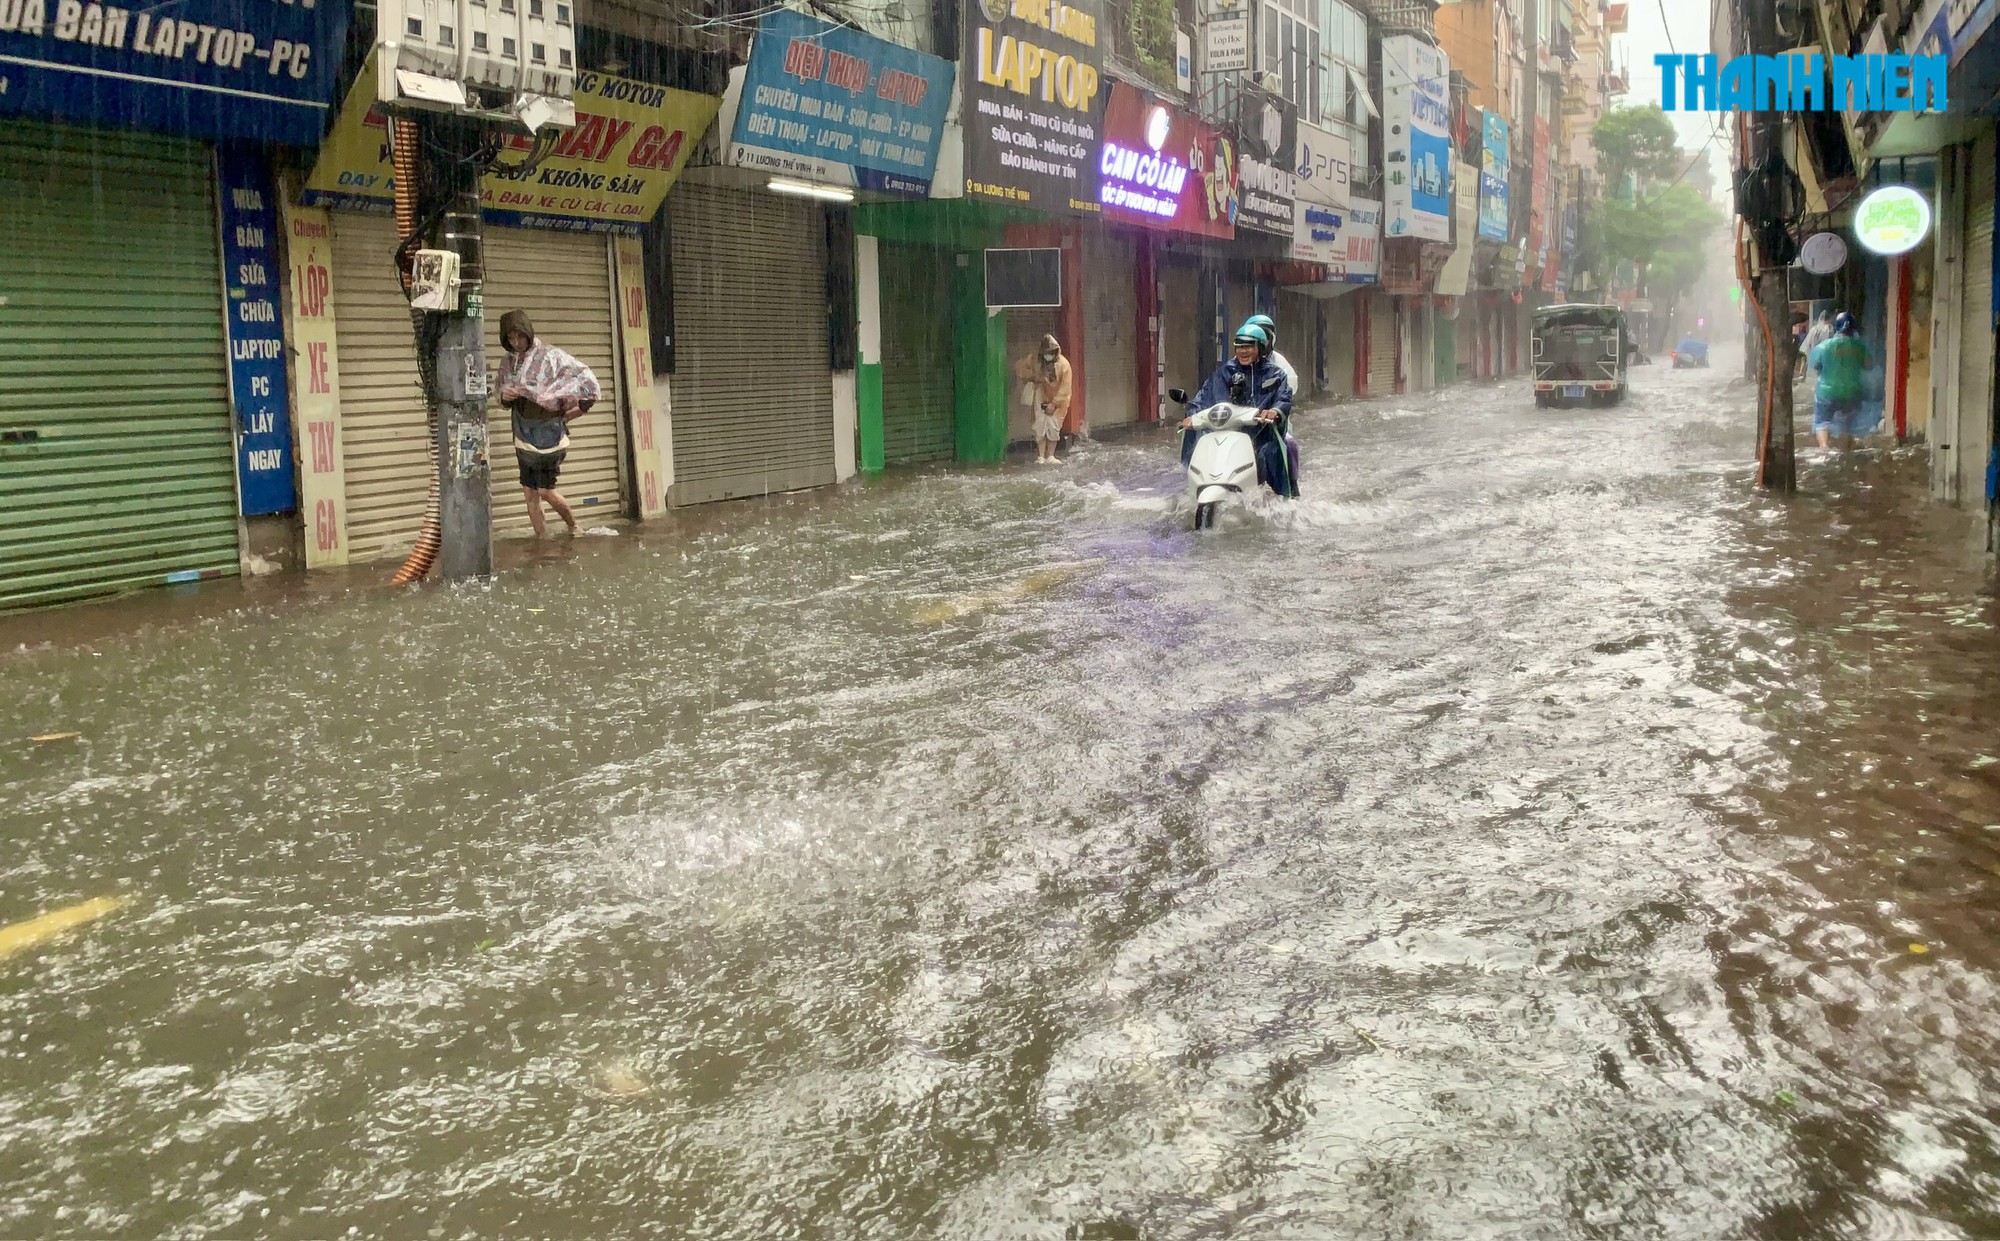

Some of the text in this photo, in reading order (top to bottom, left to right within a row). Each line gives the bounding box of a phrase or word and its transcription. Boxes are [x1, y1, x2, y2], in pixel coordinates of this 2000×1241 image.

[0, 0, 45, 38] UA
[133, 12, 310, 79] LAPTOP-PC
[1231, 48, 1245, 56] PIANO
[783, 38, 826, 85] ĐIỆN
[825, 49, 870, 98] THOẠI
[877, 66, 928, 108] LAPTOP
[978, 27, 1098, 112] LAPTOP
[575, 71, 666, 108] NG MOTOR
[755, 84, 799, 112] CHUYÊN
[800, 96, 821, 117] MUA
[823, 100, 845, 123] BÁN
[748, 112, 777, 138] ĐIỆN
[778, 119, 809, 145] THOẠI
[816, 128, 854, 151] LAPTOP
[978, 99, 1001, 117] MUA
[1003, 104, 1023, 121] BÁN
[1029, 112, 1047, 128] THU
[1048, 115, 1060, 132] CŨ
[553, 111, 635, 163] TAY
[626, 125, 687, 171] GA
[991, 124, 1011, 143] SỬA
[1012, 131, 1037, 149] CHỮA
[1044, 138, 1068, 157] NÂNG
[1069, 143, 1086, 160] CẤP
[745, 153, 754, 163] 11
[756, 156, 782, 168] LƯƠNG
[782, 157, 797, 169] THẾ
[795, 162, 812, 173] VINH
[1001, 149, 1076, 178] BẢO HÀNH UY TÍN
[1101, 142, 1139, 181] CAM
[1156, 156, 1187, 195] LÂN
[1316, 153, 1347, 185] PS5
[538, 167, 606, 190] KHÔNG
[606, 173, 646, 196] SĂM
[232, 187, 263, 212] MUA
[537, 195, 555, 208] XE
[236, 222, 264, 248] BÁN
[240, 258, 267, 285] SỬA
[240, 298, 275, 322] CHỮA
[234, 339, 281, 360] LAPTOP
[307, 342, 330, 394] XE
[251, 376, 269, 397] PC
[252, 405, 275, 433] LẤY
[249, 449, 282, 471] NGAY
[308, 421, 335, 473] TAY
[644, 470, 658, 510] GA
[316, 499, 338, 551] GA
